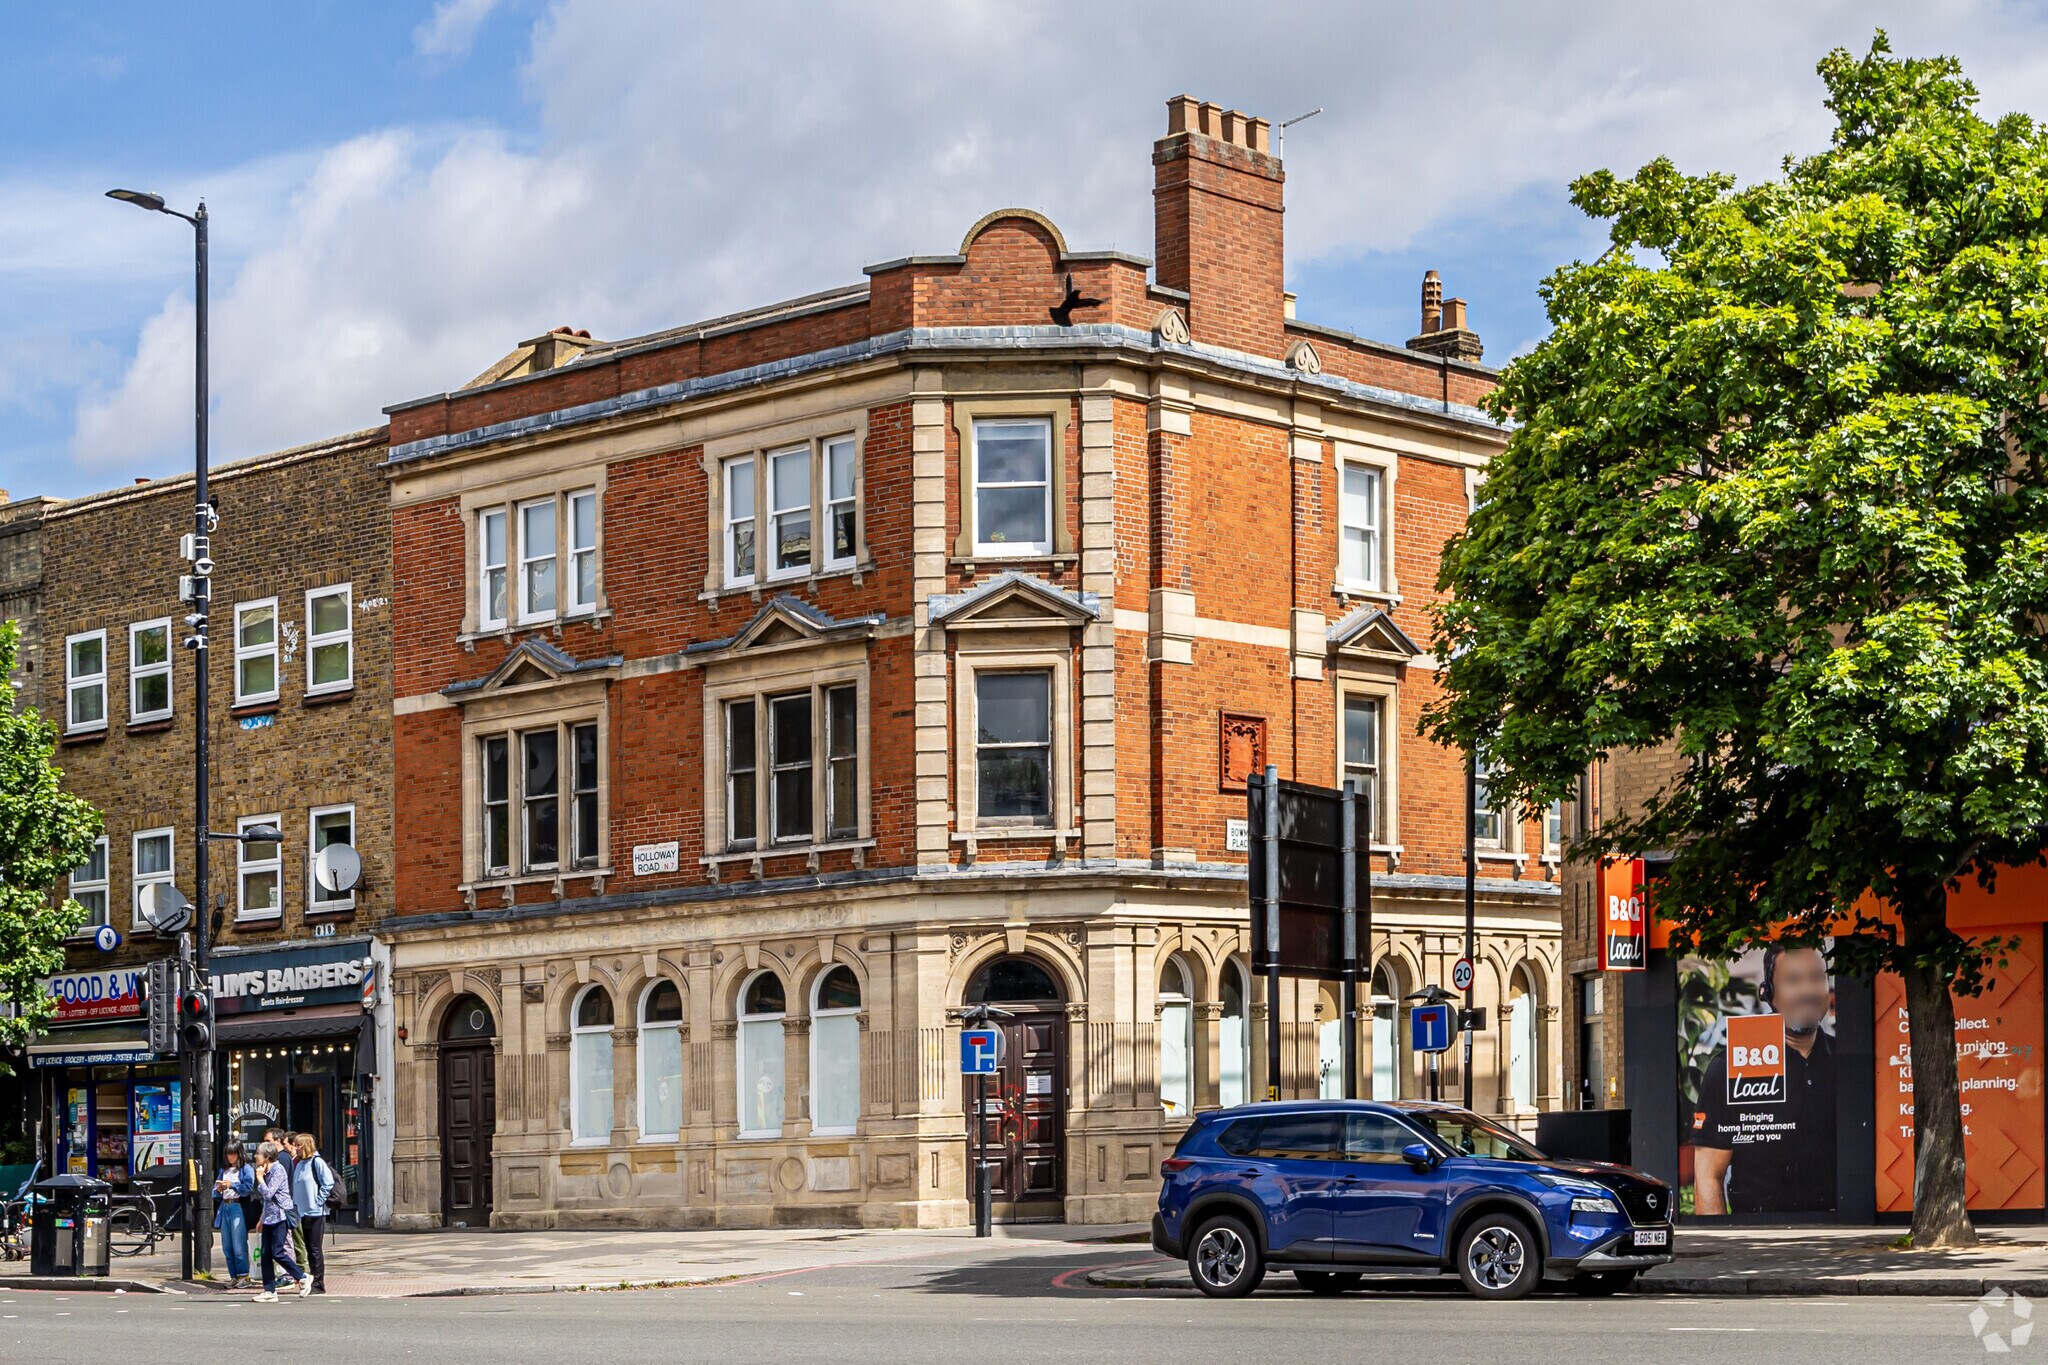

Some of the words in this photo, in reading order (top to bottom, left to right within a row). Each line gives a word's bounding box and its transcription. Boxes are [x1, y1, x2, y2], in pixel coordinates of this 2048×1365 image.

[635, 849, 676, 863] HOLLOWAY
[638, 862, 660, 873] ROAD
[1609, 895, 1640, 921] B&Q
[208, 971, 265, 998] LIM'S
[267, 960, 362, 993] BARBERS
[1456, 967, 1471, 982] 20
[53, 976, 103, 1005] FOOD
[108, 973, 121, 1000] &
[261, 997, 275, 1006] Gents
[275, 995, 305, 1005] Hairdresser
[69, 1008, 88, 1017] LOTTERY
[90, 1007, 98, 1015] OFF
[99, 1006, 117, 1014] LICENCE
[1954, 1018, 1990, 1030] ollect.
[1964, 1039, 2008, 1053] mixing.
[45, 1056, 62, 1065] LICENCE
[64, 1055, 84, 1064] GROCERY
[87, 1054, 112, 1063] NEWSPAPER
[135, 1052, 155, 1061] LOTTERY
[1733, 1044, 1780, 1067] B&Q
[1733, 1072, 1780, 1098] Local
[1962, 1076, 2018, 1092] planning.
[249, 1098, 279, 1122] BARBERS
[1740, 1113, 1774, 1122] Bringing
[1717, 1124, 1741, 1132] home
[1742, 1122, 1796, 1134] improvement
[1732, 1131, 1755, 1142] closer
[1756, 1133, 1764, 1141] to
[1766, 1133, 1781, 1142] you
